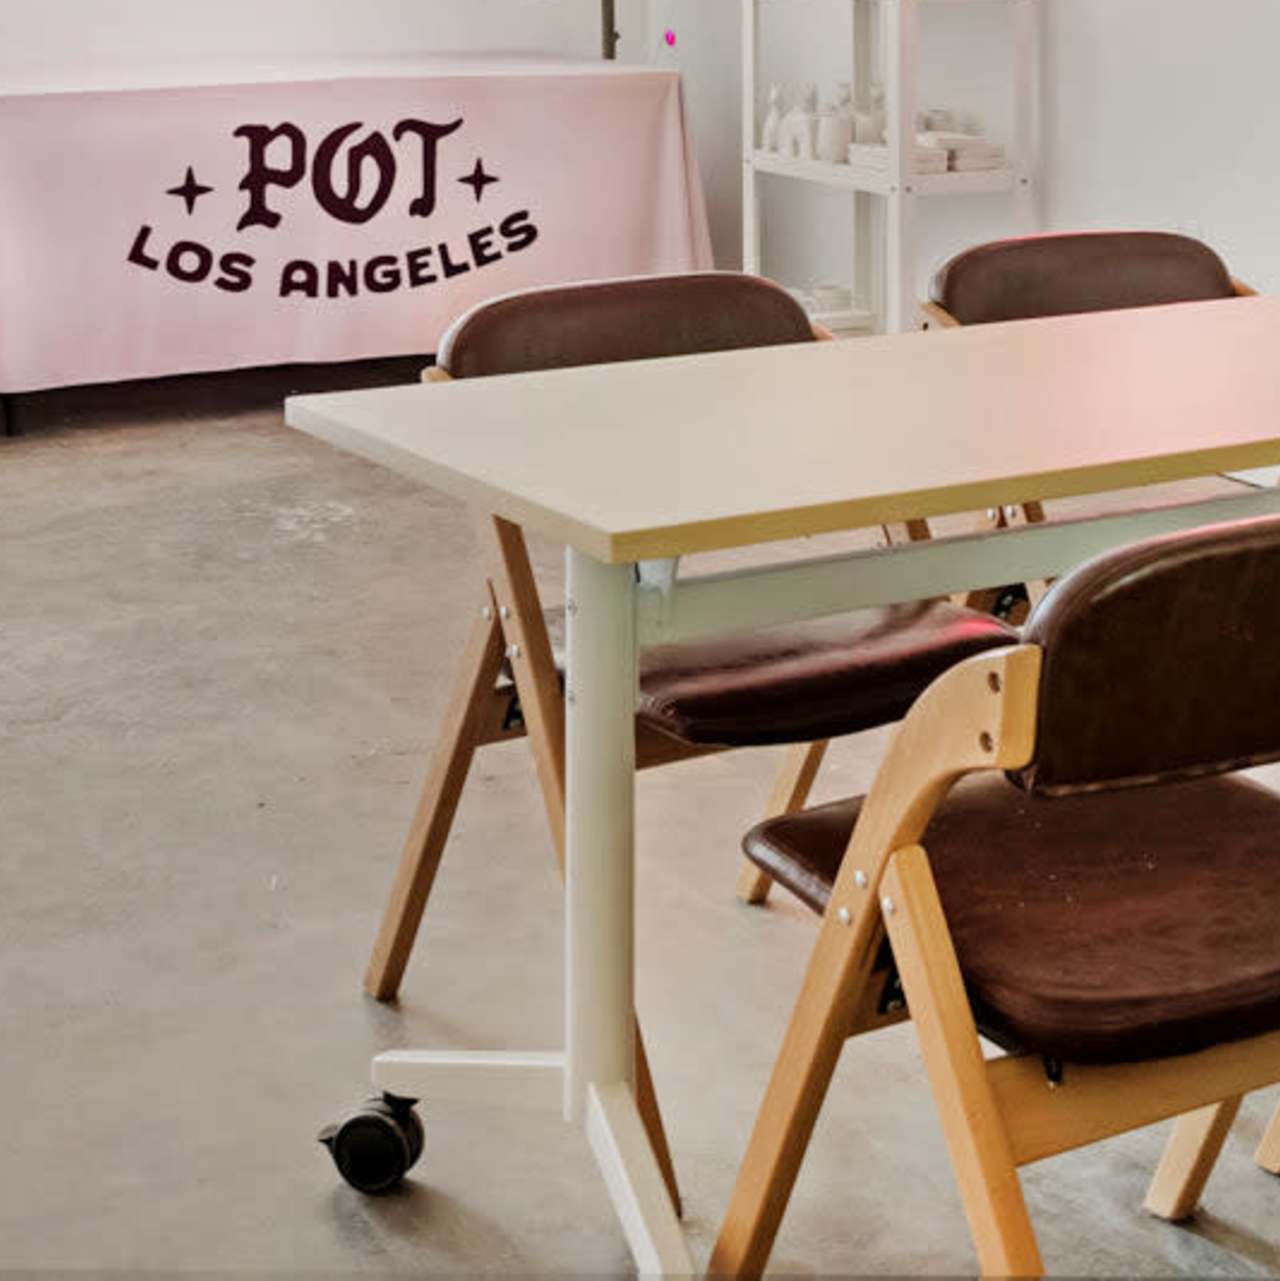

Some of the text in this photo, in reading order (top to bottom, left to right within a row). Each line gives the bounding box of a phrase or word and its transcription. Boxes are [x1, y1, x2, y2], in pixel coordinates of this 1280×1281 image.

[233, 117, 463, 232] POT
[127, 210, 539, 298] LOS ANGELES
